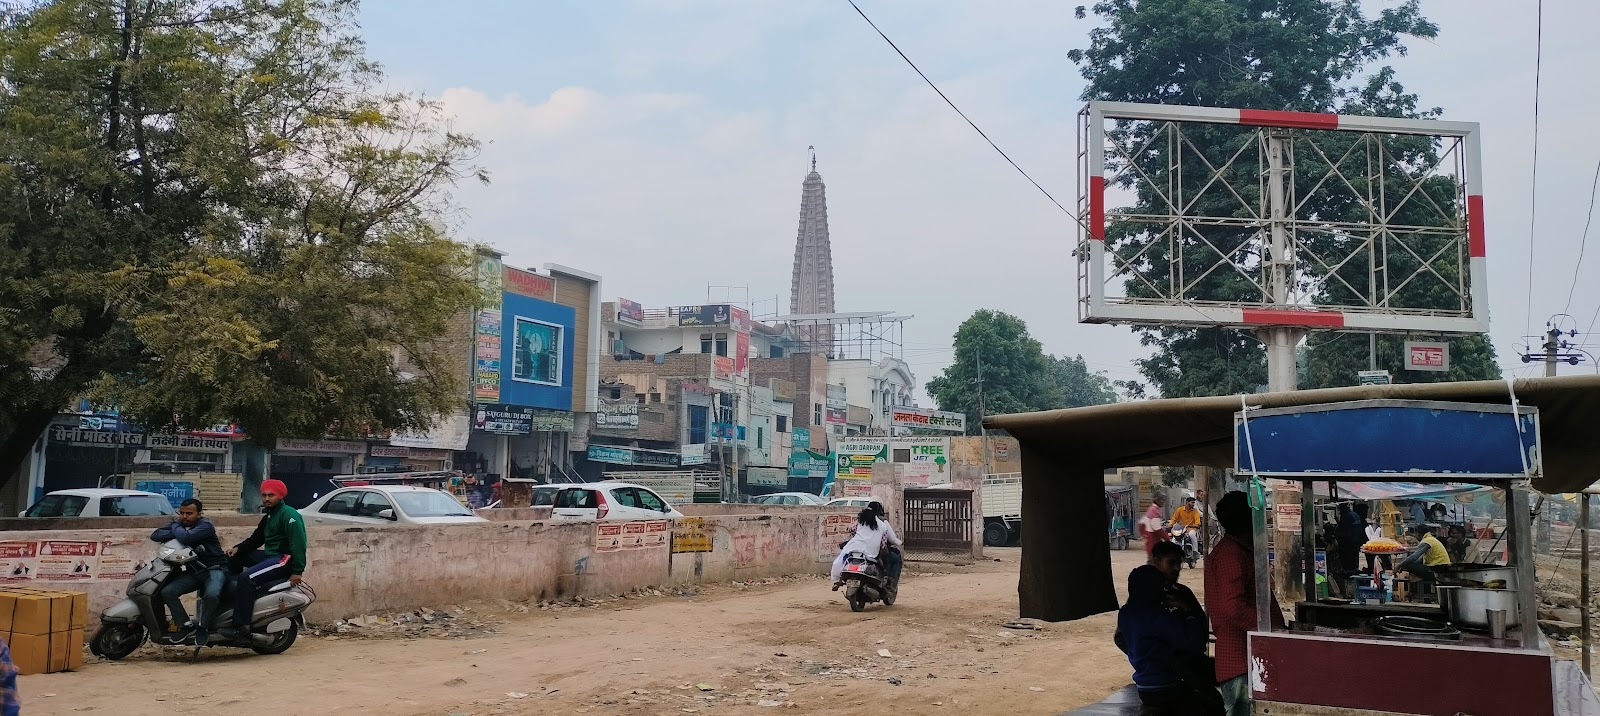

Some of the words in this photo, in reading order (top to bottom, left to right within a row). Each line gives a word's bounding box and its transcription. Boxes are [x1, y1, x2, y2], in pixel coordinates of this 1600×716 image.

[508, 270, 552, 292] WADHWA
[517, 285, 545, 296] COMPLEX
[479, 378, 497, 386] IFFCO
[893, 411, 912, 422] जनता
[55, 426, 81, 441] सैनी
[83, 429, 113, 443] मोटर
[151, 435, 180, 446] लक्ष्मी
[180, 436, 203, 448] ऑटो
[911, 445, 944, 454] TREE
